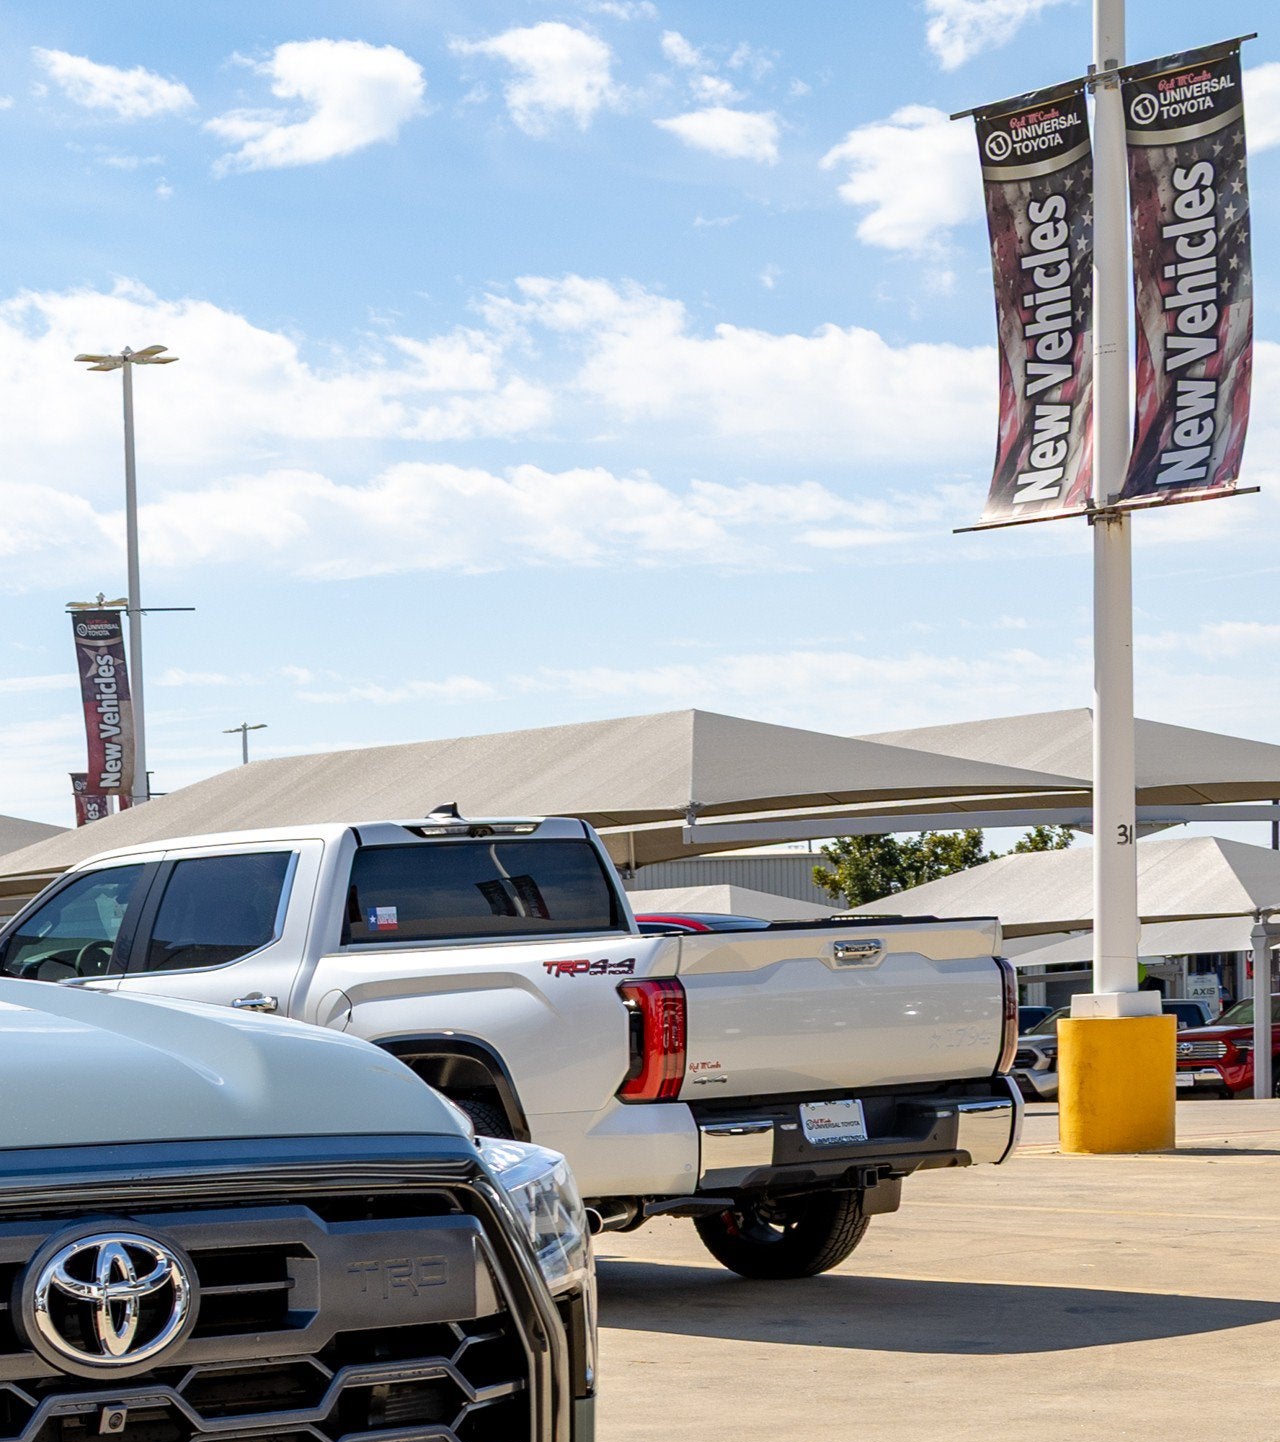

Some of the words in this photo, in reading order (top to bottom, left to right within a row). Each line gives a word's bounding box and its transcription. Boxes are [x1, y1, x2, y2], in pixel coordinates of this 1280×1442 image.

[1160, 75, 1235, 105] UNIVERSAL
[1160, 96, 1214, 120] TOYOTA
[1011, 112, 1081, 142] UNIVERSAL
[1013, 132, 1063, 156] TOYOTA
[1163, 161, 1219, 374] Vehicles
[1021, 194, 1073, 398] Vehicles
[1156, 379, 1217, 487] New
[1013, 404, 1072, 504] New
[94, 653, 121, 740] Vehicles
[99, 742, 123, 789] New
[1116, 823, 1133, 845] 31
[543, 959, 590, 977] TRD
[1192, 987, 1216, 997] AXIS
[814, 1122, 841, 1130] UNIVERSAL
[345, 1255, 449, 1300] TRD
